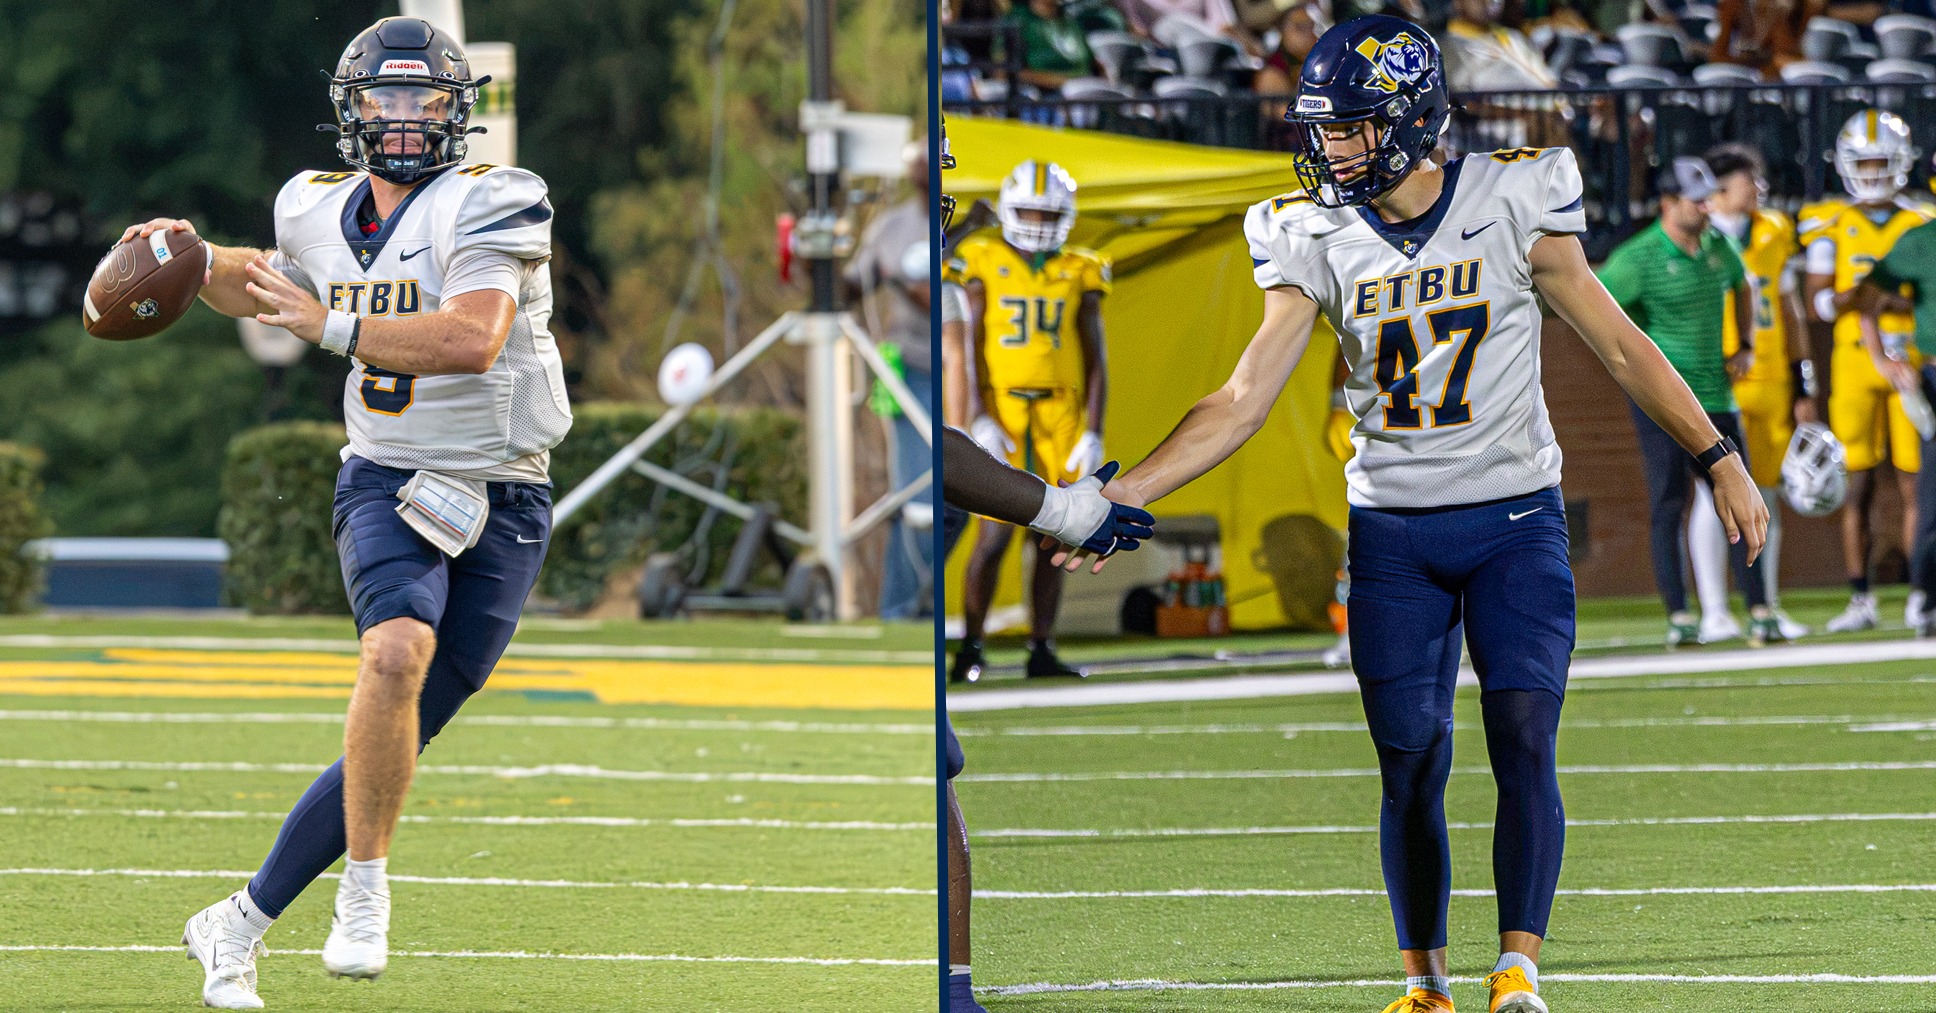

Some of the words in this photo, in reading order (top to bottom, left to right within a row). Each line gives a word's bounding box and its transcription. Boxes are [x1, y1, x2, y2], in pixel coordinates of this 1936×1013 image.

[1302, 99, 1322, 110] TIGERS
[156, 247, 168, 259] 01
[327, 279, 422, 318] ETBU
[1353, 258, 1483, 318] ETBU
[1000, 296, 1065, 349] 34
[1372, 300, 1491, 431] 47
